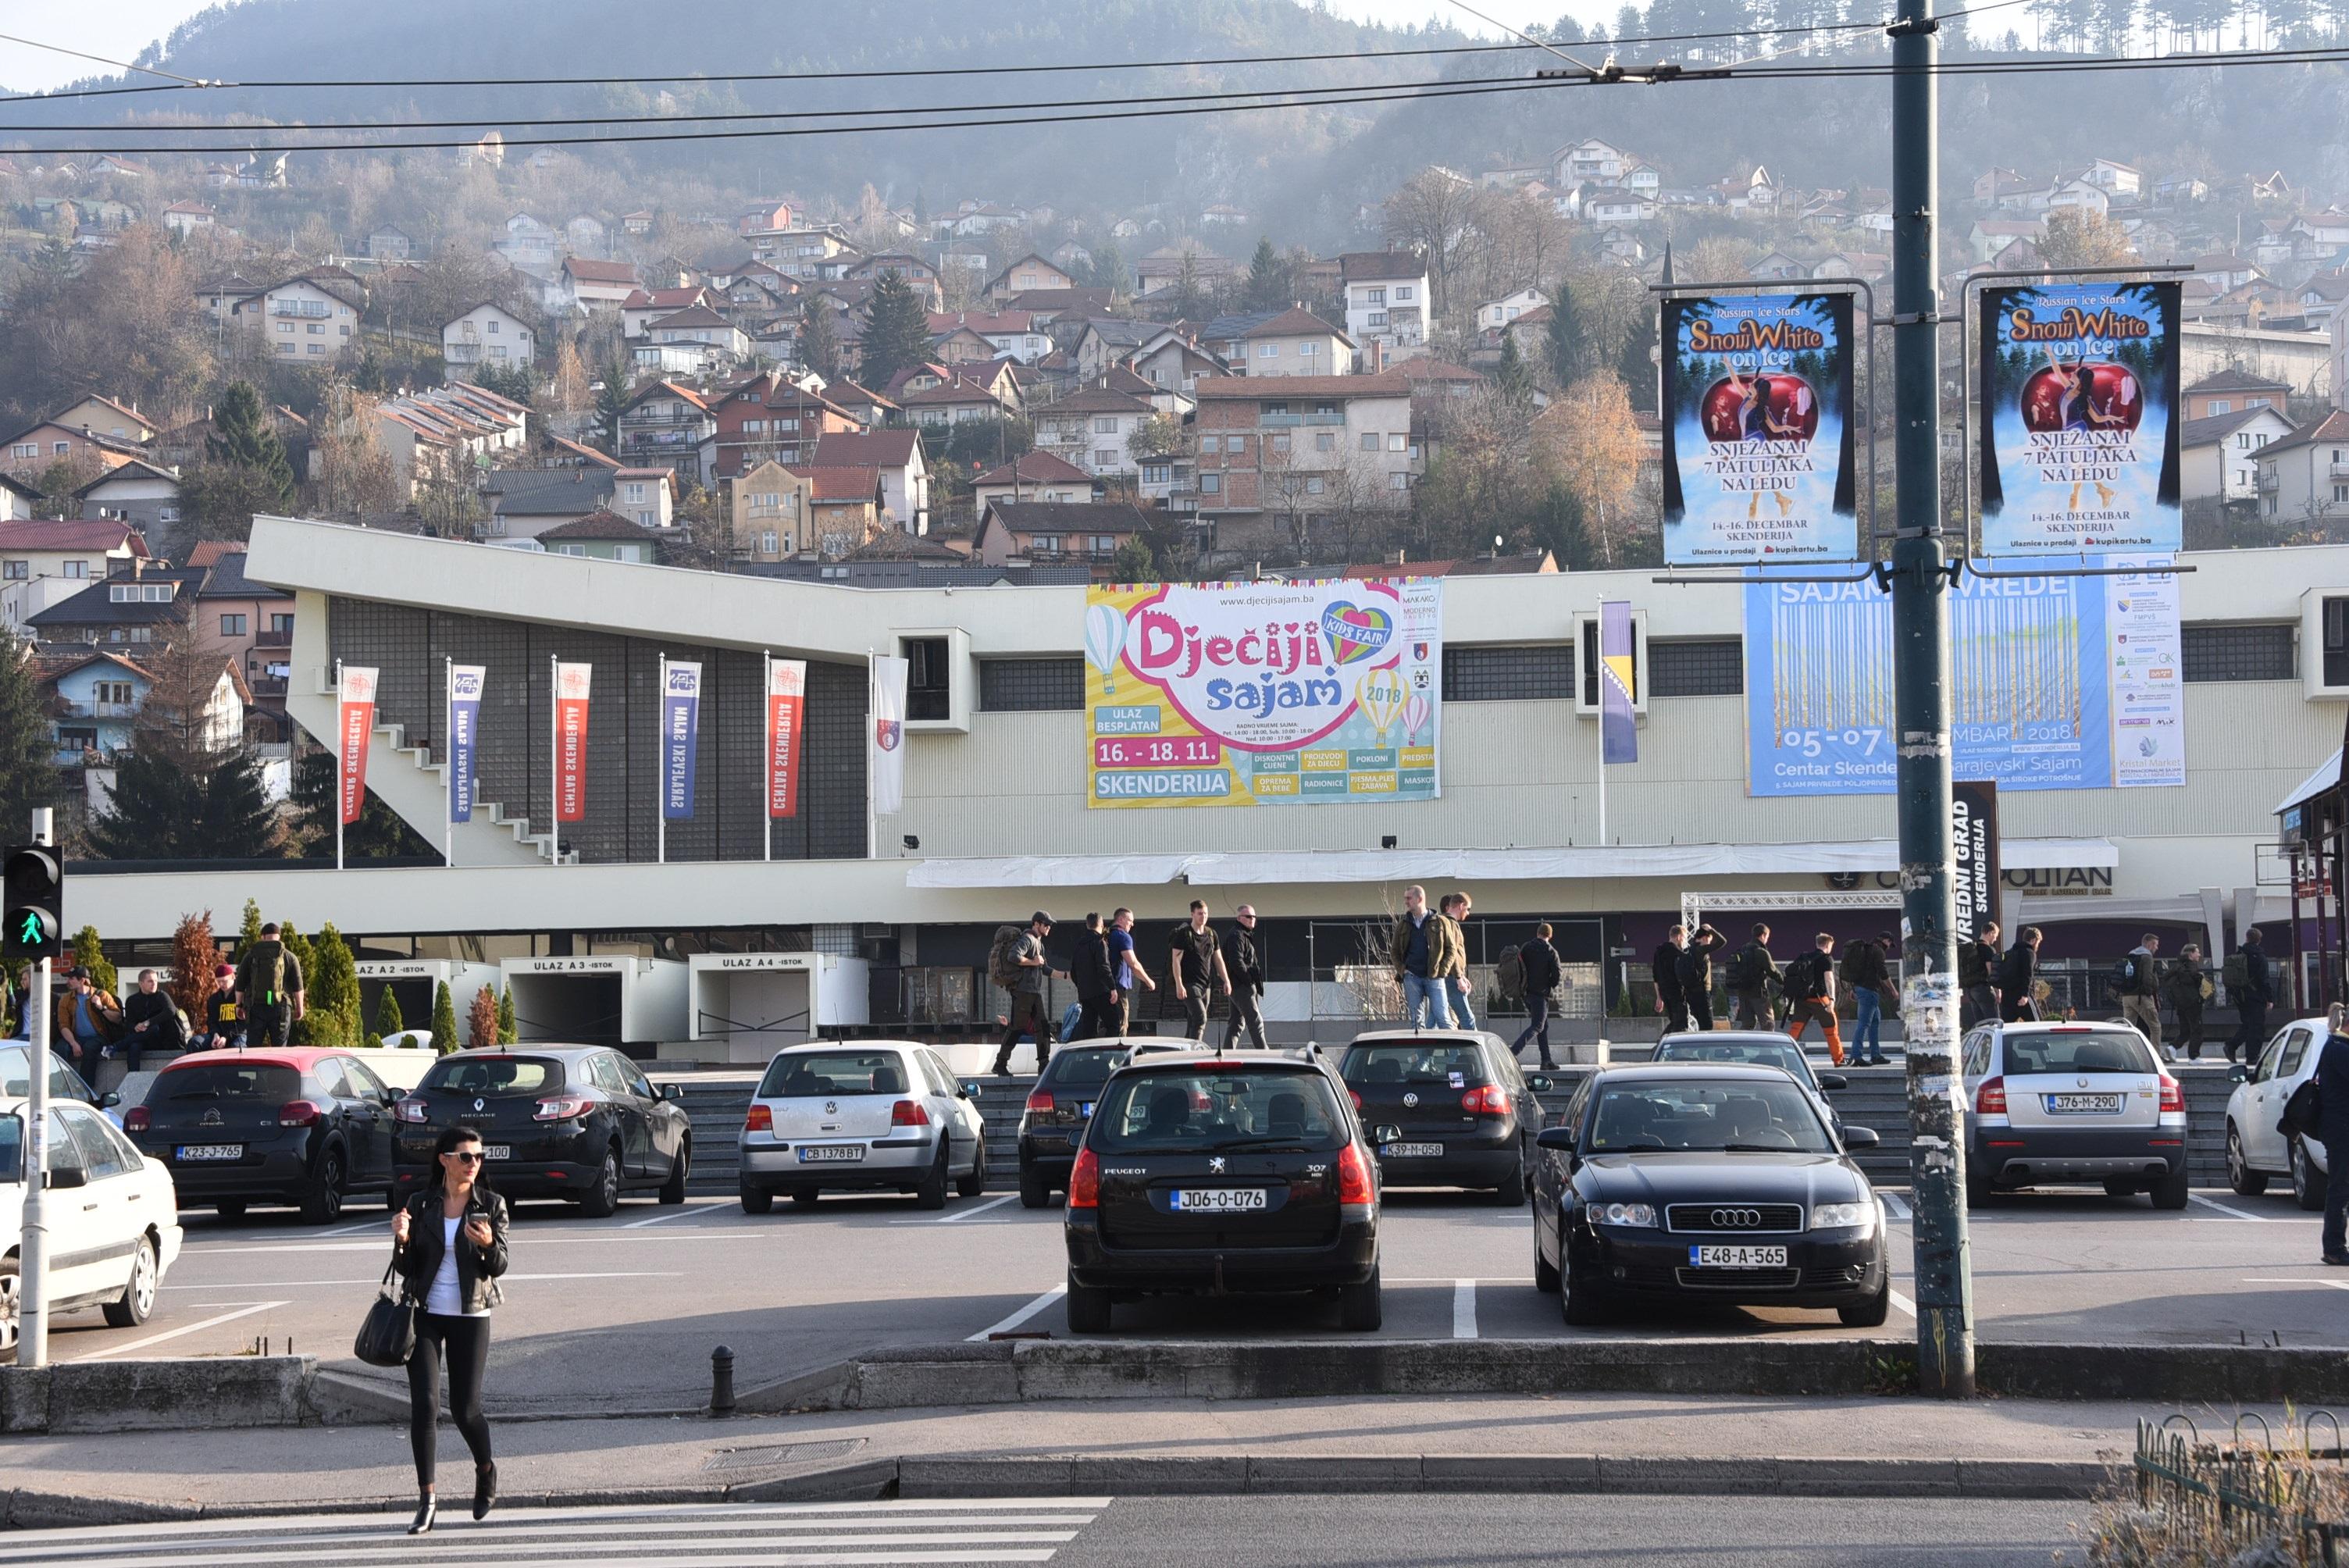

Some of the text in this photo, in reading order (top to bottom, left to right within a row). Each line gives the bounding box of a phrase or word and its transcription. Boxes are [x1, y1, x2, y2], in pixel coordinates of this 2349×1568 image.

[2036, 294, 2126, 308] Russian Ice Stars
[1714, 306, 1801, 319] Russian Ice Stars
[2053, 340, 2080, 356] on
[1731, 351, 1757, 367] on
[2030, 431, 2130, 449] SNJEŽANA I
[1710, 440, 1806, 458] SNJEŽANA I
[2024, 449, 2137, 465] 7 PATULJAKA
[1704, 458, 1813, 475] 7 PATULJAKA
[2042, 467, 2119, 482] NA LEDU
[1722, 476, 1797, 490] NA LEDU
[2067, 511, 2131, 521] DECEMBAR
[1746, 519, 1808, 529] DECEMBAR
[2046, 523, 2115, 533] SKENDERIJA
[1726, 531, 1794, 541] SKENDERIJA
[2051, 539, 2077, 548] prodaji
[2096, 537, 2152, 547] kupikartu.ba
[1731, 547, 1756, 557] prodaji
[1776, 544, 1828, 554] kupikartu.ba
[1220, 594, 1314, 607] www.djecijisajam.ba
[1326, 618, 1355, 639] KIDS
[1356, 629, 1385, 646] FAIR
[1141, 609, 1323, 679] Dječiji
[1207, 672, 1342, 719] sajam
[1367, 686, 1402, 704] 2018
[1113, 709, 1142, 719] ULAZ
[1097, 721, 1159, 732] BESPLATAN
[2028, 724, 2071, 741] 2018
[1100, 743, 1130, 762] 16.
[1149, 742, 1179, 761] 18.
[1186, 741, 1217, 761] 11.
[1303, 753, 1343, 761] PROIZVODI
[1254, 754, 1296, 763] DISKONTNE
[1356, 755, 1388, 764] POKLONI
[2031, 756, 2082, 773] Sajam
[2119, 758, 2181, 768] Kristal Market
[1775, 762, 1831, 776] Centar
[1098, 773, 1227, 795] SKENDERIJA
[1260, 777, 1292, 786] OPREMA
[1304, 779, 1344, 788] RADIONICE
[1952, 800, 1971, 861] GRAD
[1973, 818, 1987, 914] SKENDERIJA
[534, 961, 563, 971] ULAZ
[722, 959, 751, 968] ULAZ
[2056, 1096, 2116, 1108] J76-M-290
[184, 1145, 241, 1158] K23-J-765
[1387, 1144, 1442, 1156] K39-M-058
[1306, 1164, 1328, 1173] 307
[1701, 1247, 1786, 1264] E48-A-565
